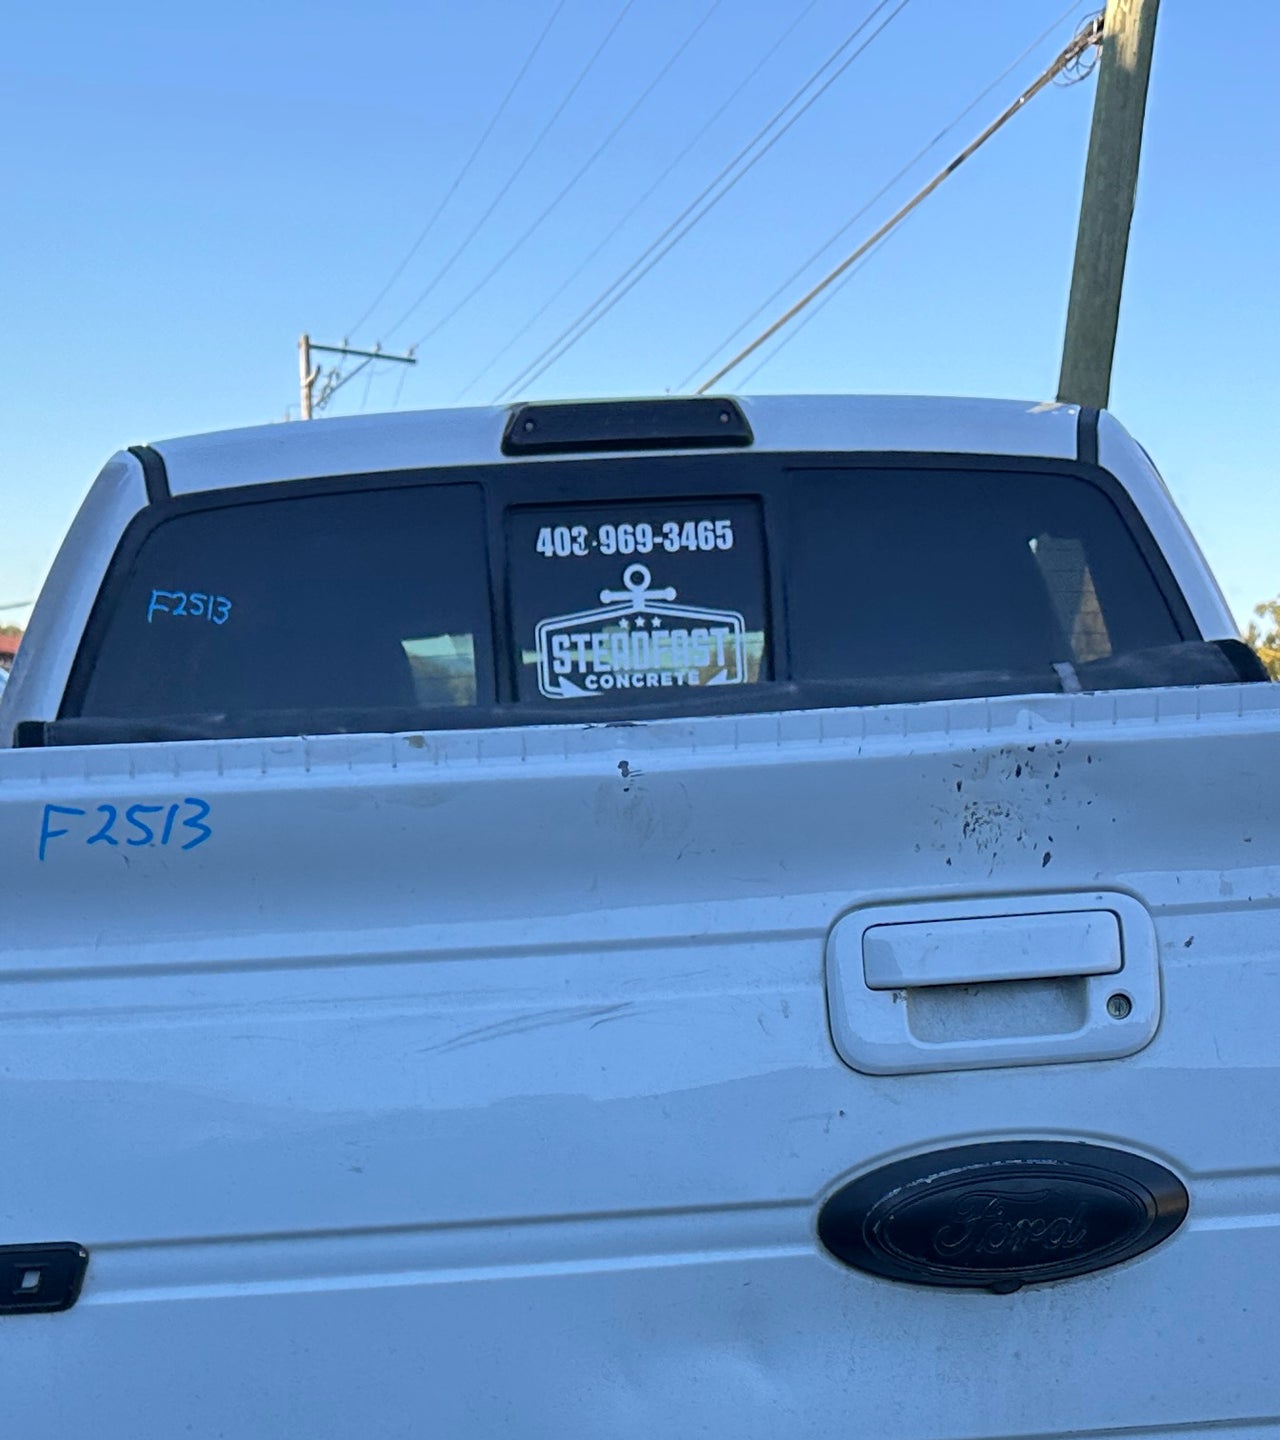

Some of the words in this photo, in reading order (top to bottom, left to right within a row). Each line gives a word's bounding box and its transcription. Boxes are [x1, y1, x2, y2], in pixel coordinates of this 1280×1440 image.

[147, 589, 232, 625] F2513
[551, 627, 730, 674] STEADFAST
[584, 670, 701, 690] CONCRETE
[38, 797, 213, 861] F2513
[933, 1188, 1090, 1257] Ford
